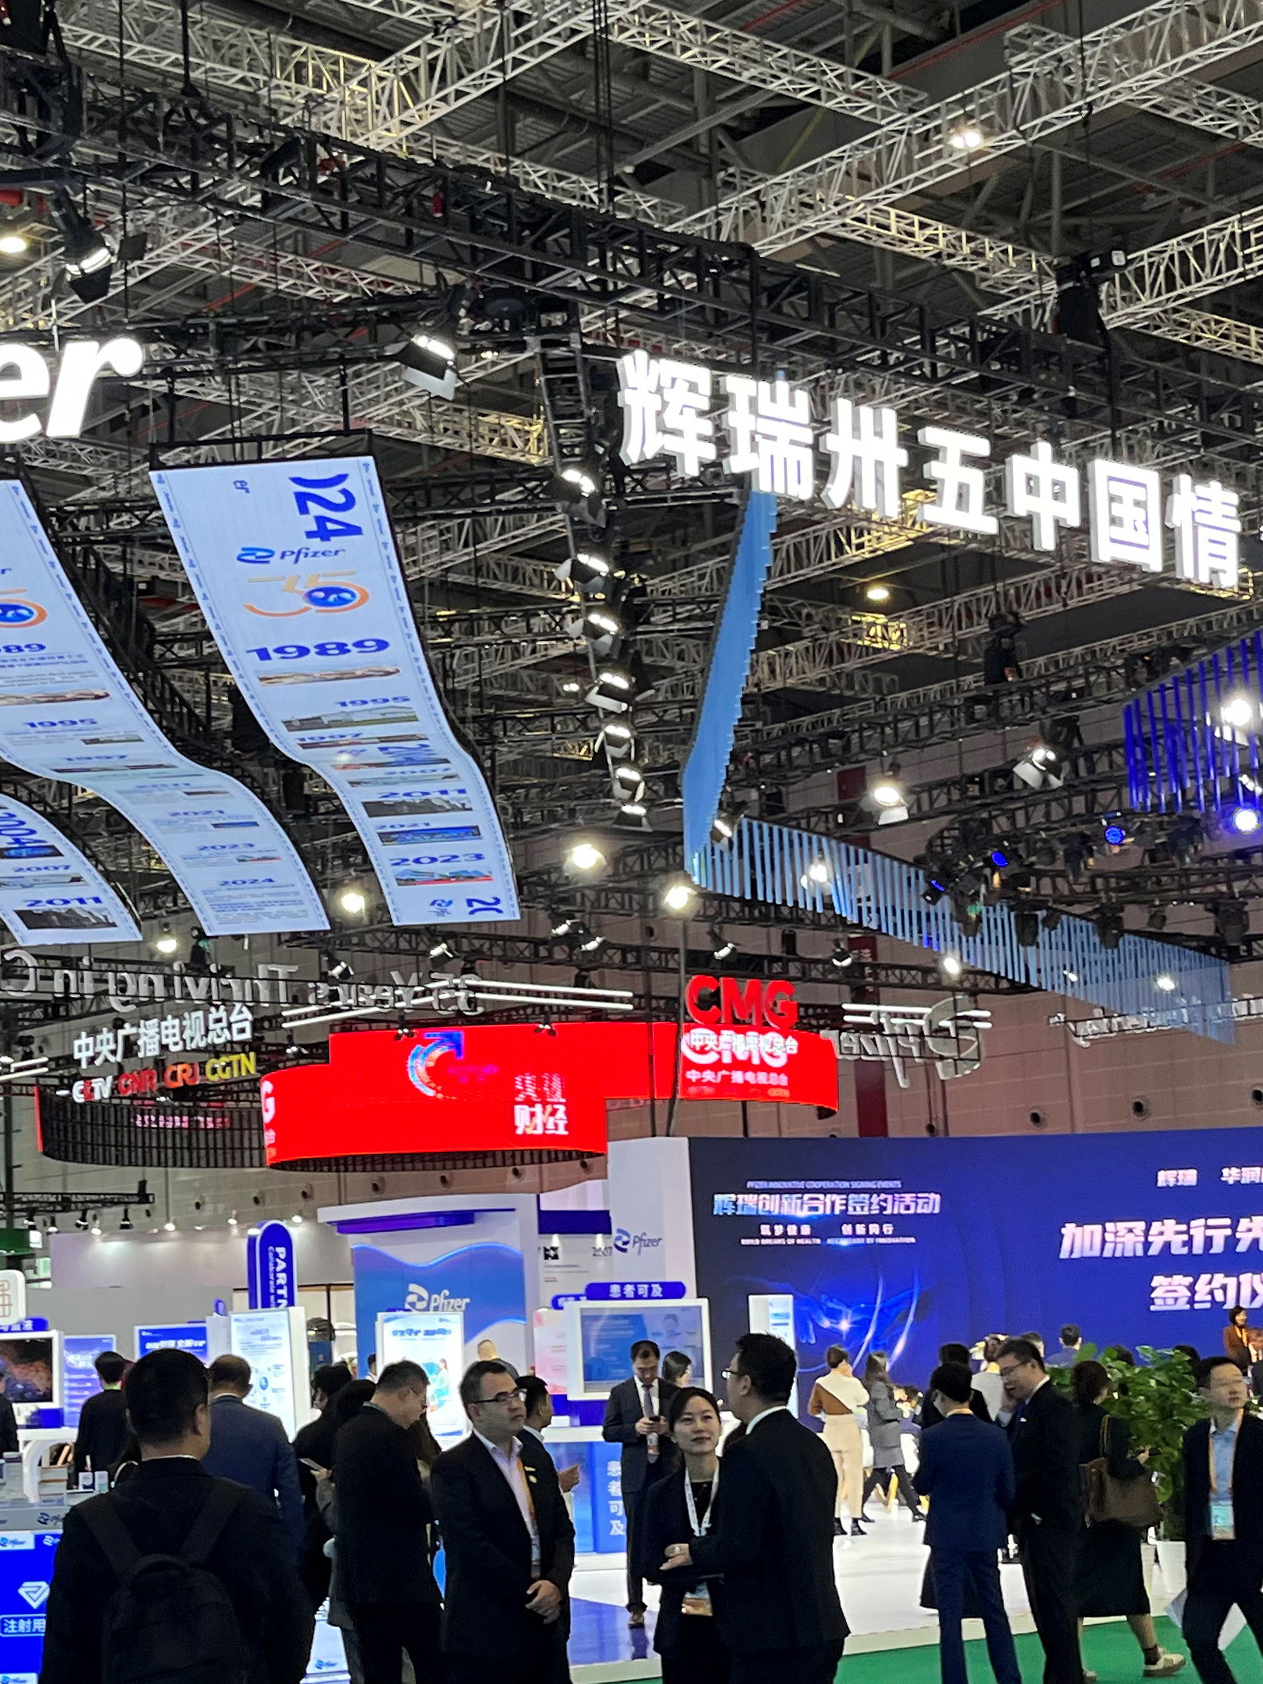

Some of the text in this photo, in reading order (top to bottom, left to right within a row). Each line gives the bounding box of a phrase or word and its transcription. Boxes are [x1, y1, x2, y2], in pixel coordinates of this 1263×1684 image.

[617, 350, 1241, 589] 辉瑞卅五中国情
[280, 547, 345, 564] Pfizer
[245, 638, 390, 661] 1989
[379, 788, 467, 798] 2011
[391, 853, 486, 866] 2023
[27, 896, 103, 907] 2011
[685, 974, 799, 1030] CMG
[73, 1003, 253, 1069] 中央广播电视总台
[686, 1069, 788, 1086] 中央广播电视总台
[514, 1103, 568, 1135] 财经
[1157, 1166, 1263, 1188] 辉瑞 华润
[713, 1193, 941, 1215] 辉瑞创新合作签约活动
[632, 1232, 663, 1256] Pfizer
[430, 1289, 471, 1312] Pfizer
[609, 1284, 663, 1298] 患者可及
[3, 1615, 46, 1634] 注射用
